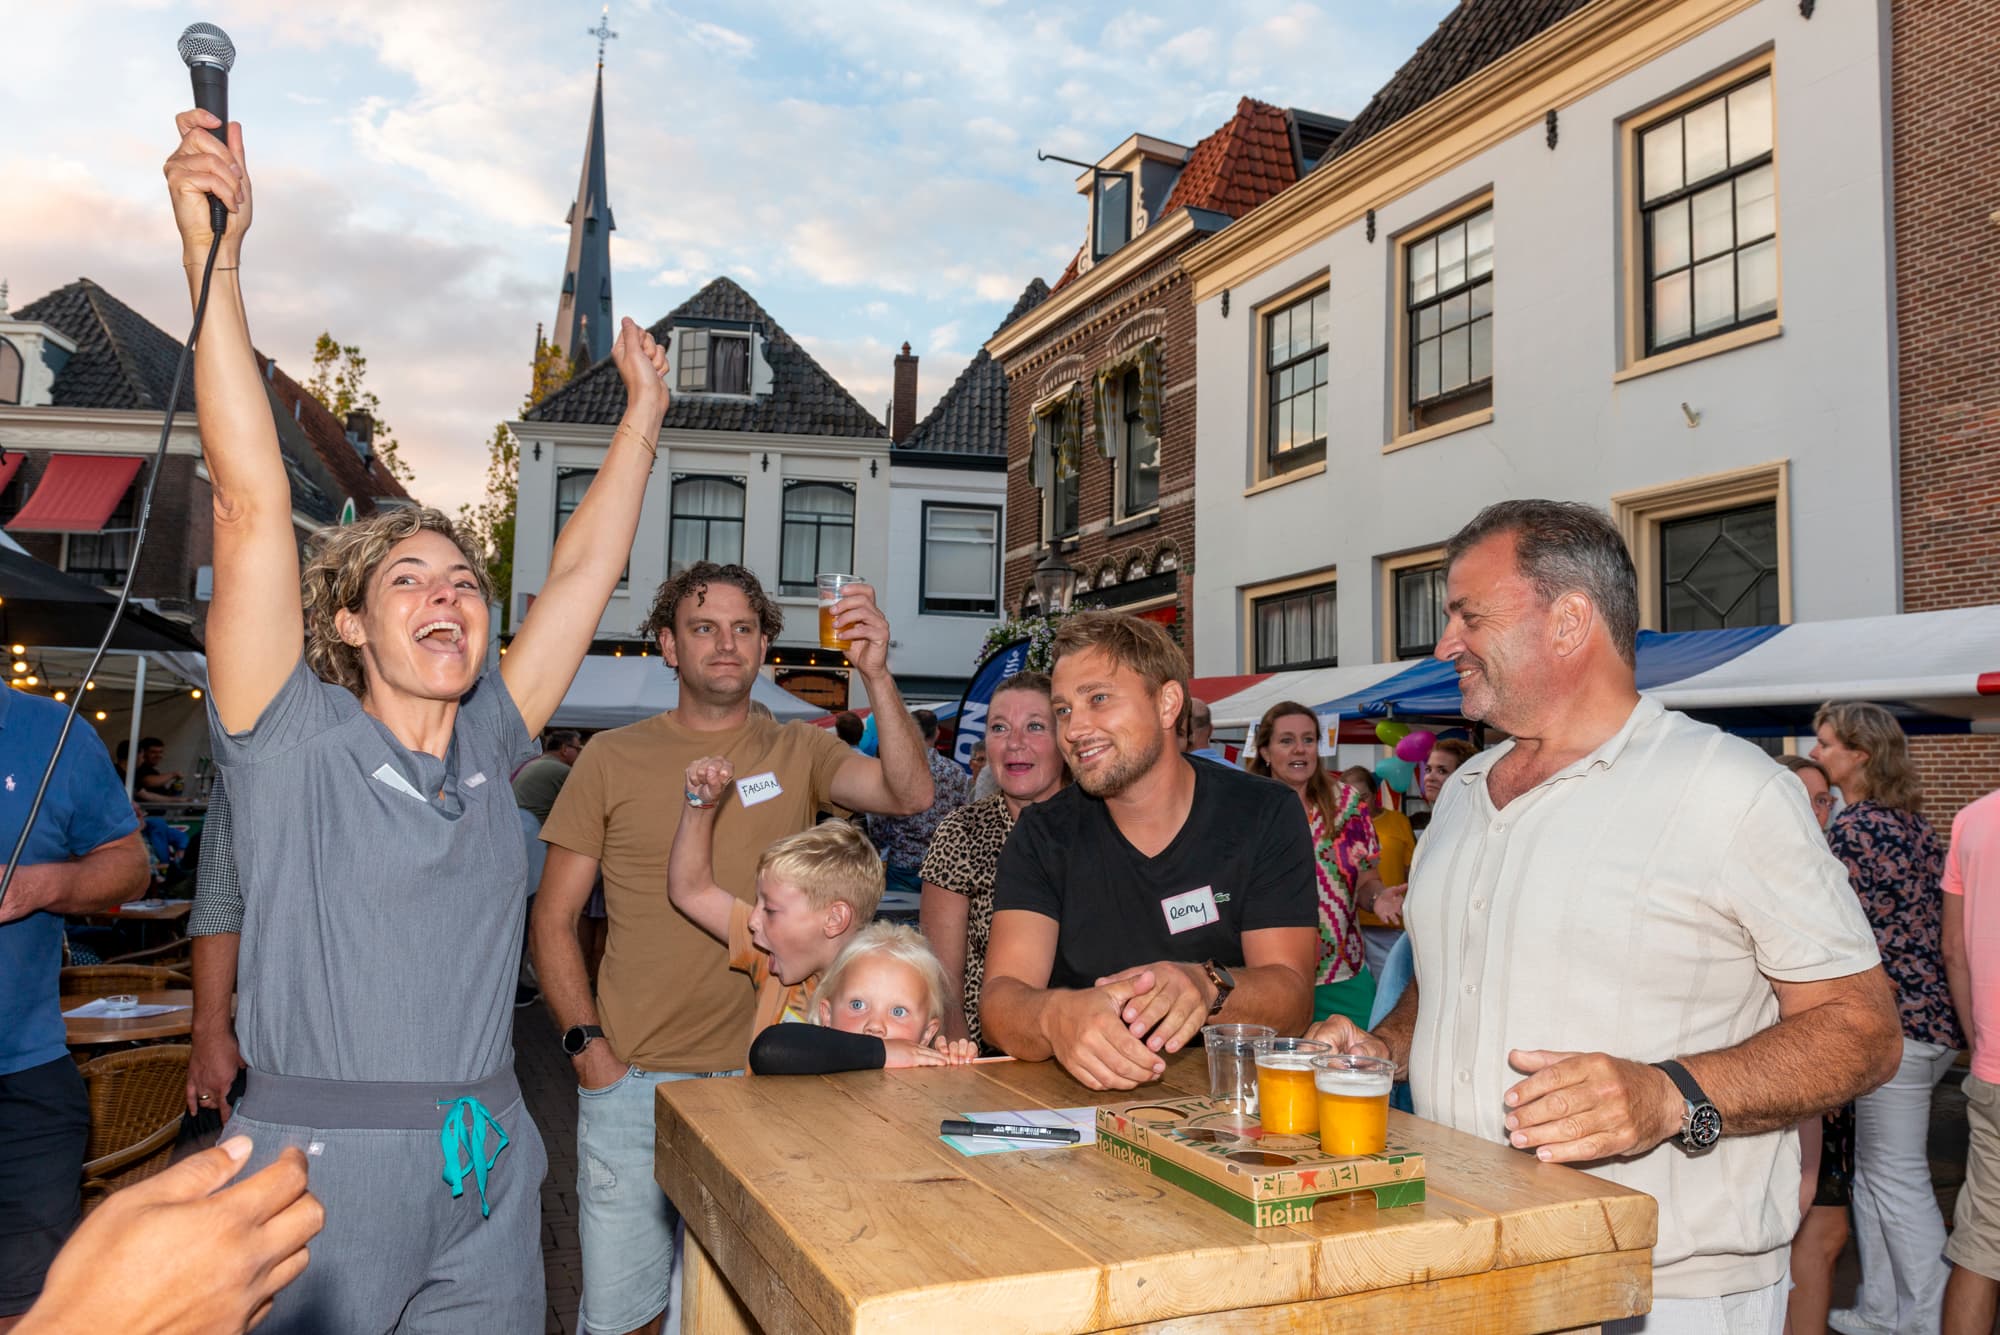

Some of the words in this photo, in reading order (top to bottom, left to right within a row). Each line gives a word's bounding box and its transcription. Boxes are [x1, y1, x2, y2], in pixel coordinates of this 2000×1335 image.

[741, 780, 779, 798] FABIAN
[1170, 902, 1208, 923] Remy
[1096, 1132, 1152, 1173] Heineken
